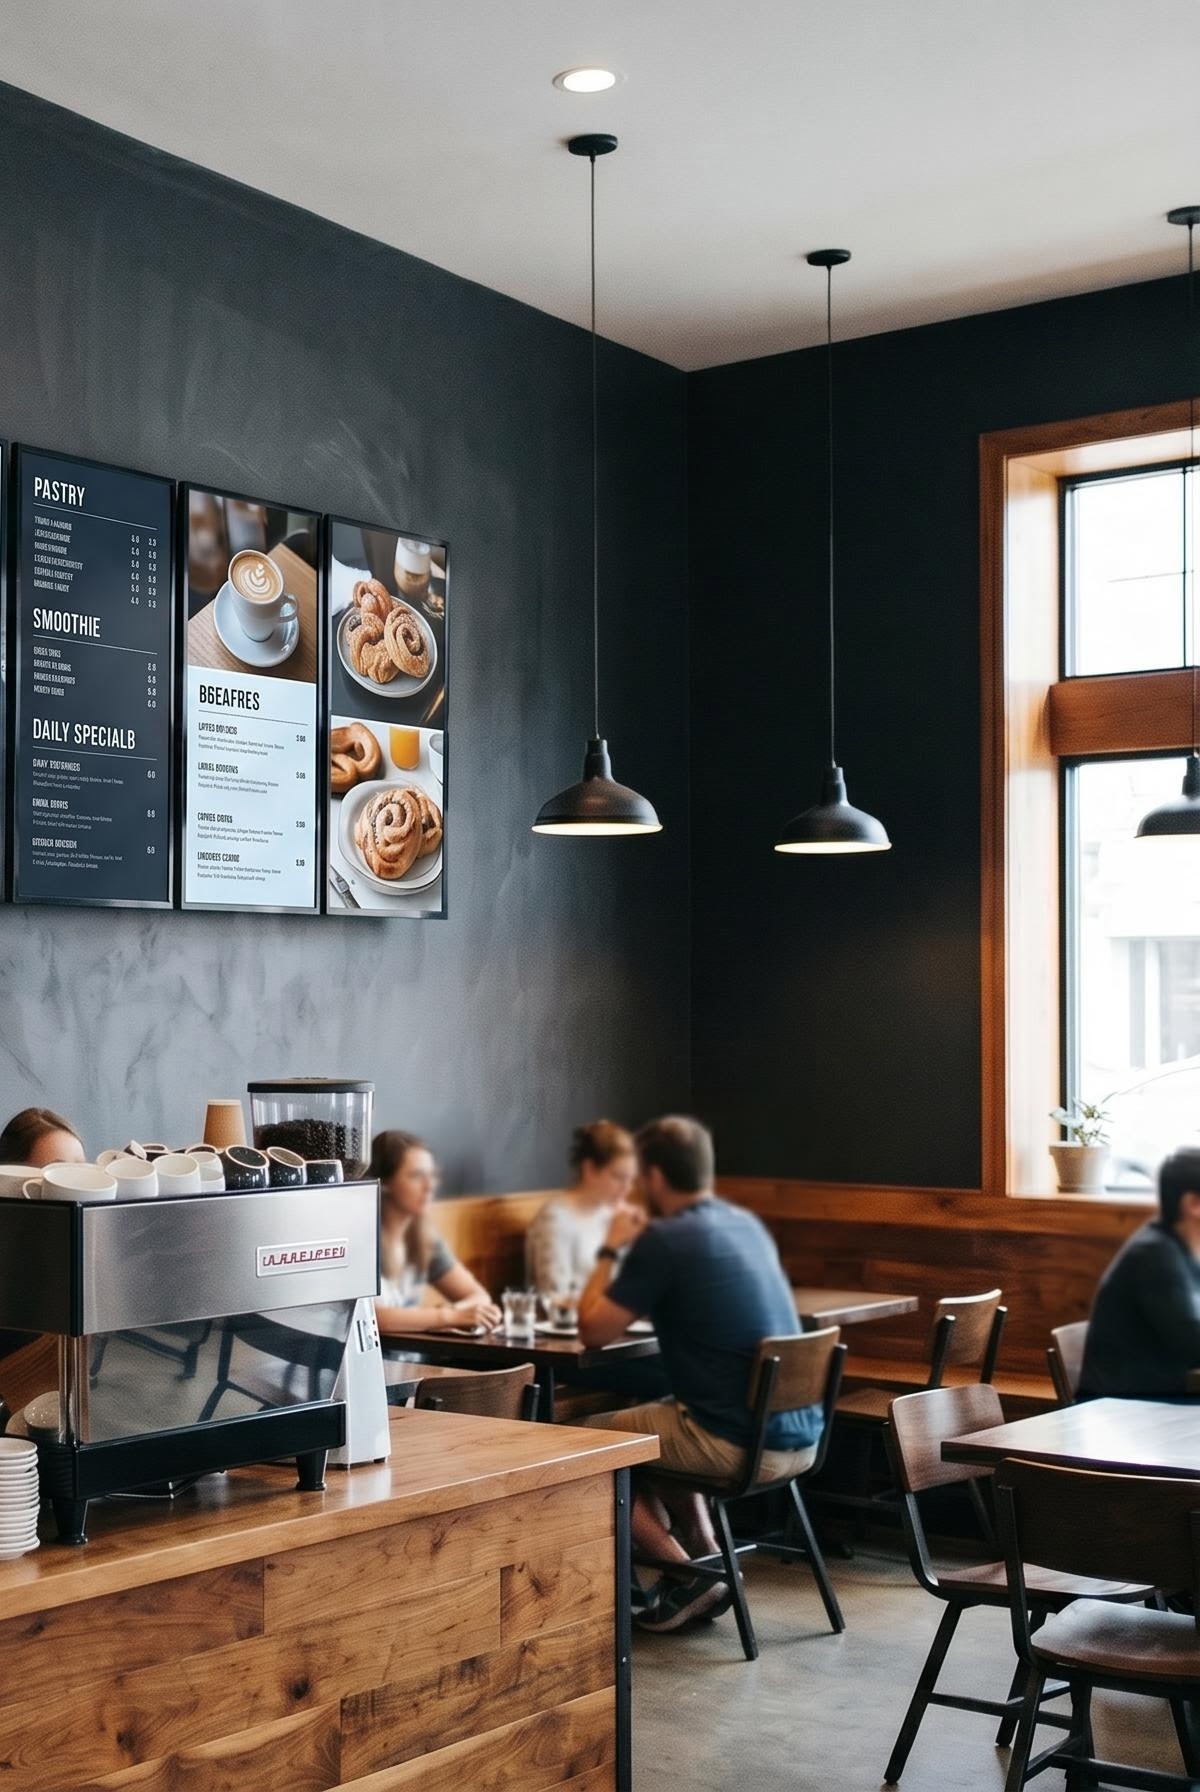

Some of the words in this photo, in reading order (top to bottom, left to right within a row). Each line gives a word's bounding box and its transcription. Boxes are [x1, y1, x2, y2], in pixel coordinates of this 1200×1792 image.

[34, 476, 85, 507] PASTRY
[33, 607, 101, 638] SMOOTHIE
[199, 684, 260, 710] B6EAFRES
[33, 718, 69, 742] DAILY
[74, 723, 136, 750] SPECIALB
